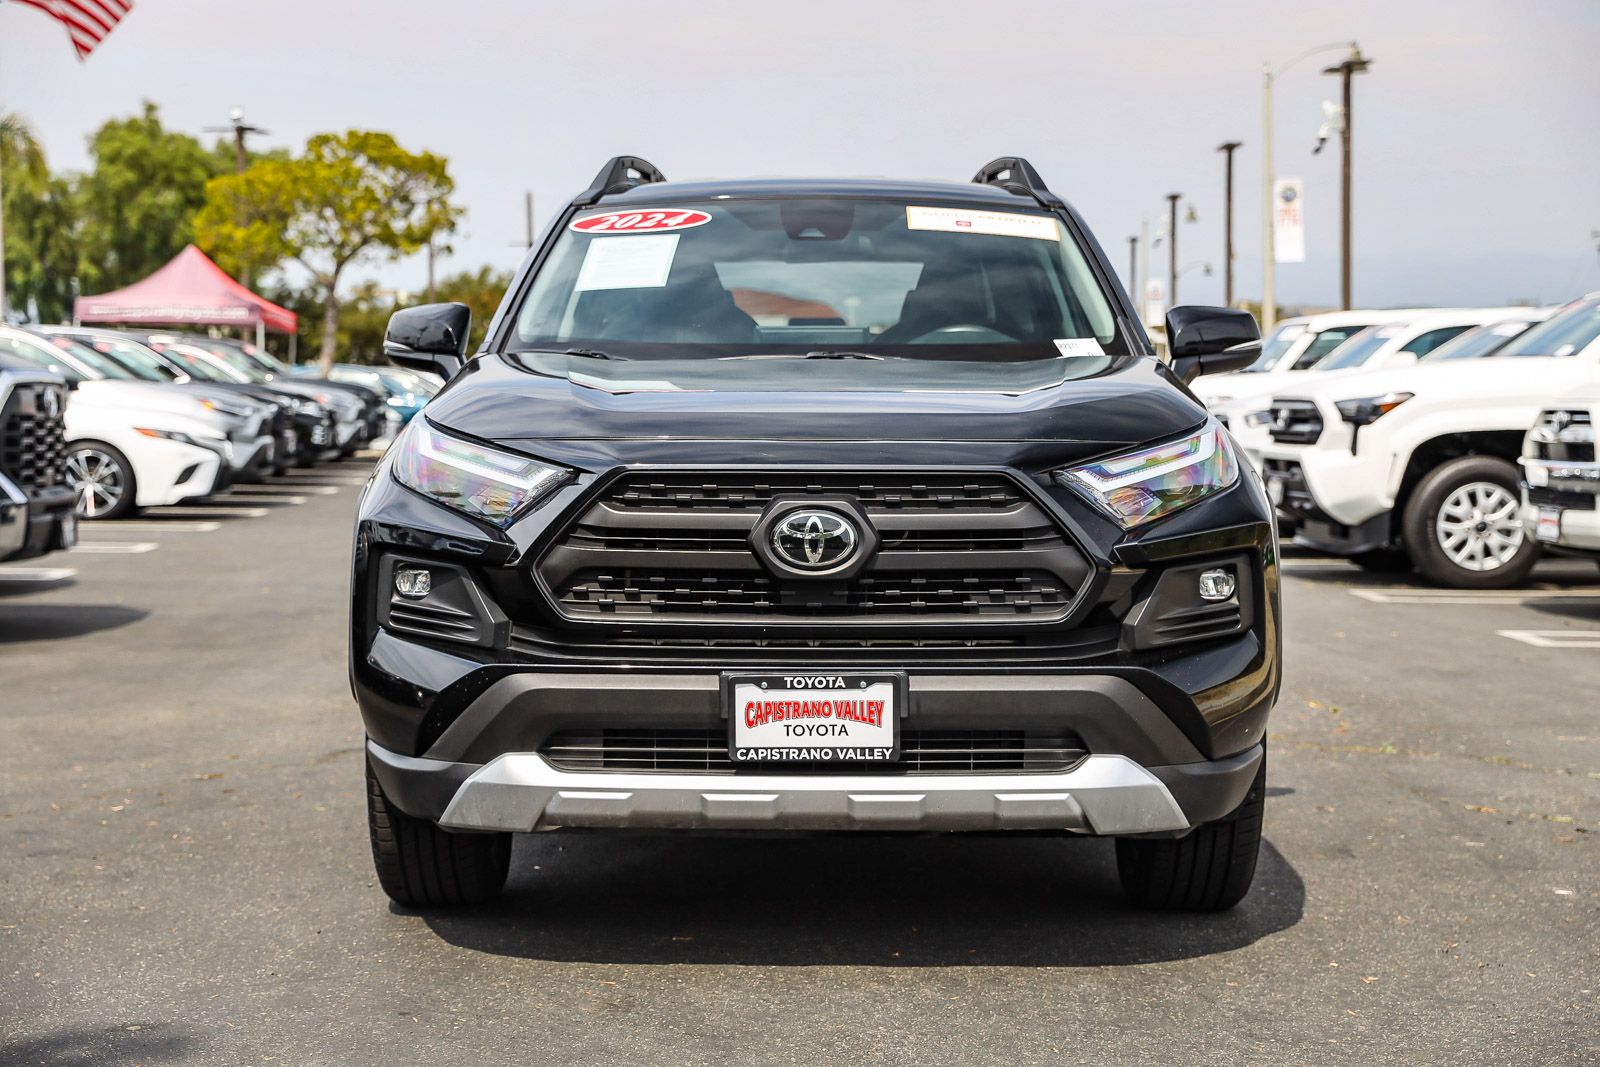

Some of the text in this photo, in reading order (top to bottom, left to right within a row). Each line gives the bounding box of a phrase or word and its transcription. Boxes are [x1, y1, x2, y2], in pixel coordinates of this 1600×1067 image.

[590, 212, 693, 230] 2024
[784, 677, 846, 688] TOYOTA
[745, 700, 885, 728] CAPISTRANO VALLEY
[784, 724, 849, 736] TOYOTA
[736, 749, 893, 760] CAPISTRANO VALLEY
